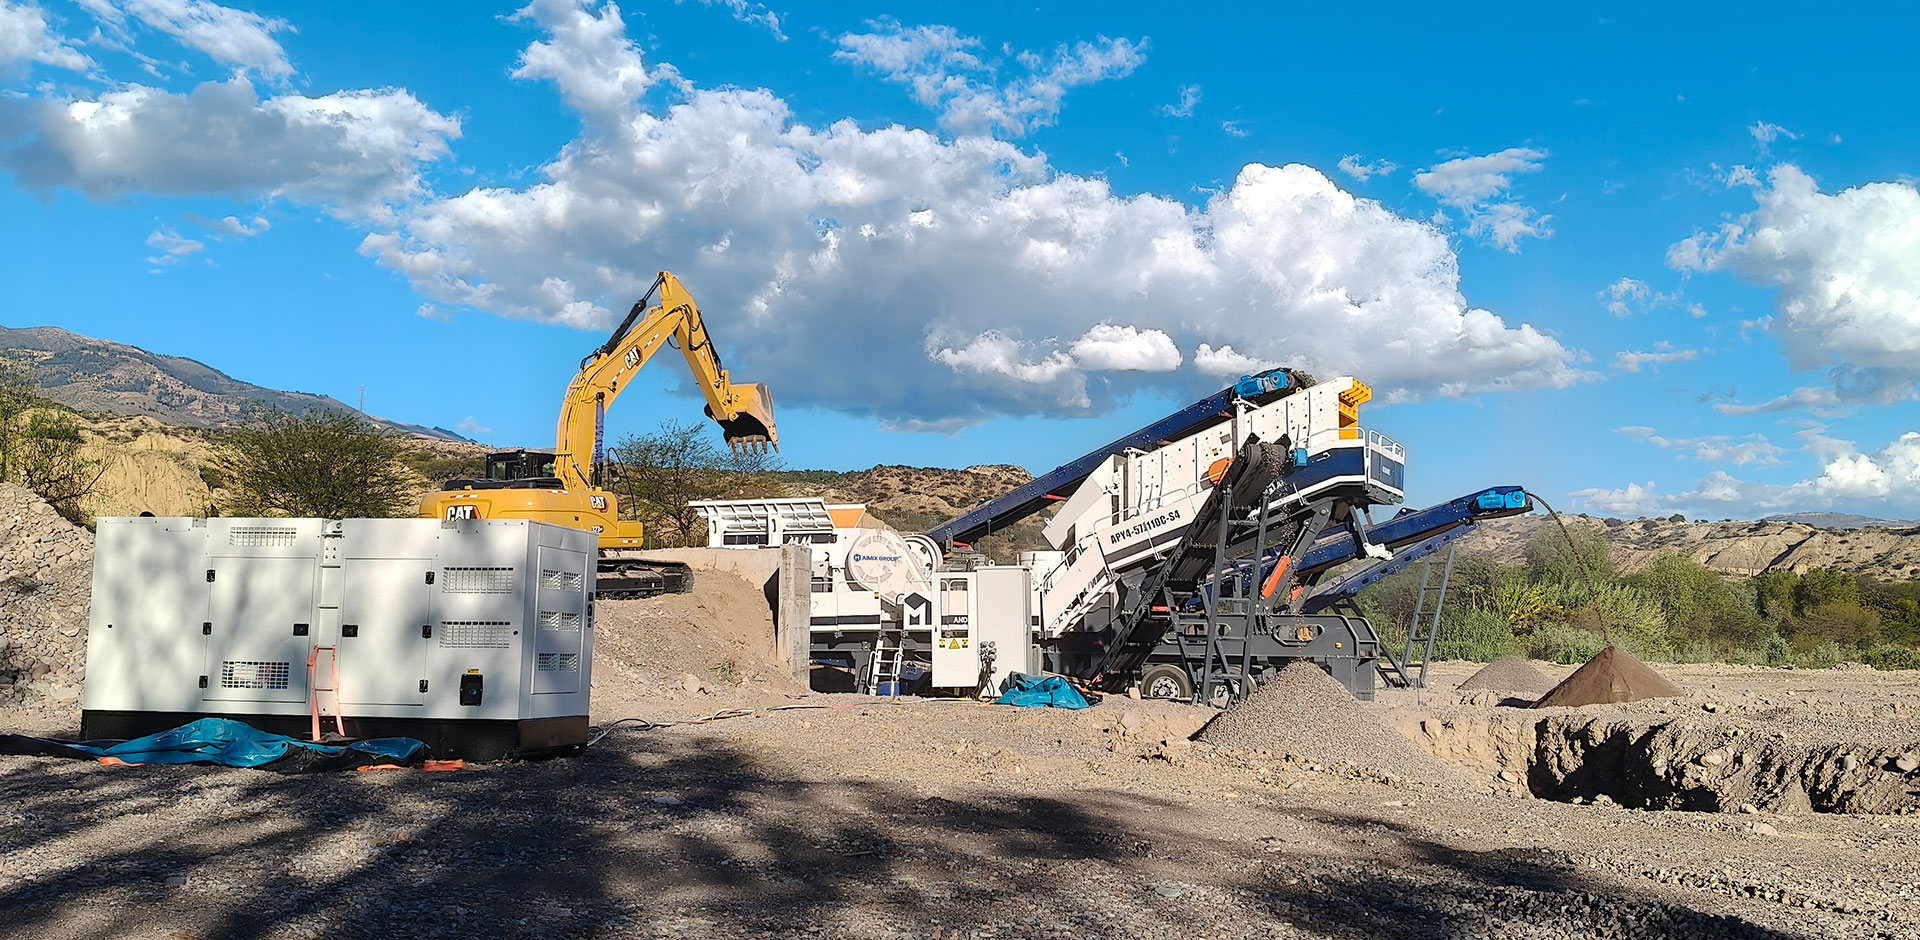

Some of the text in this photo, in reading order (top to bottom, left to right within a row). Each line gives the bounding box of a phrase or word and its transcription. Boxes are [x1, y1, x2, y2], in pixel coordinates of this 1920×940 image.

[624, 346, 640, 369] CAT
[590, 496, 605, 509] CAT
[447, 505, 474, 521] CAT
